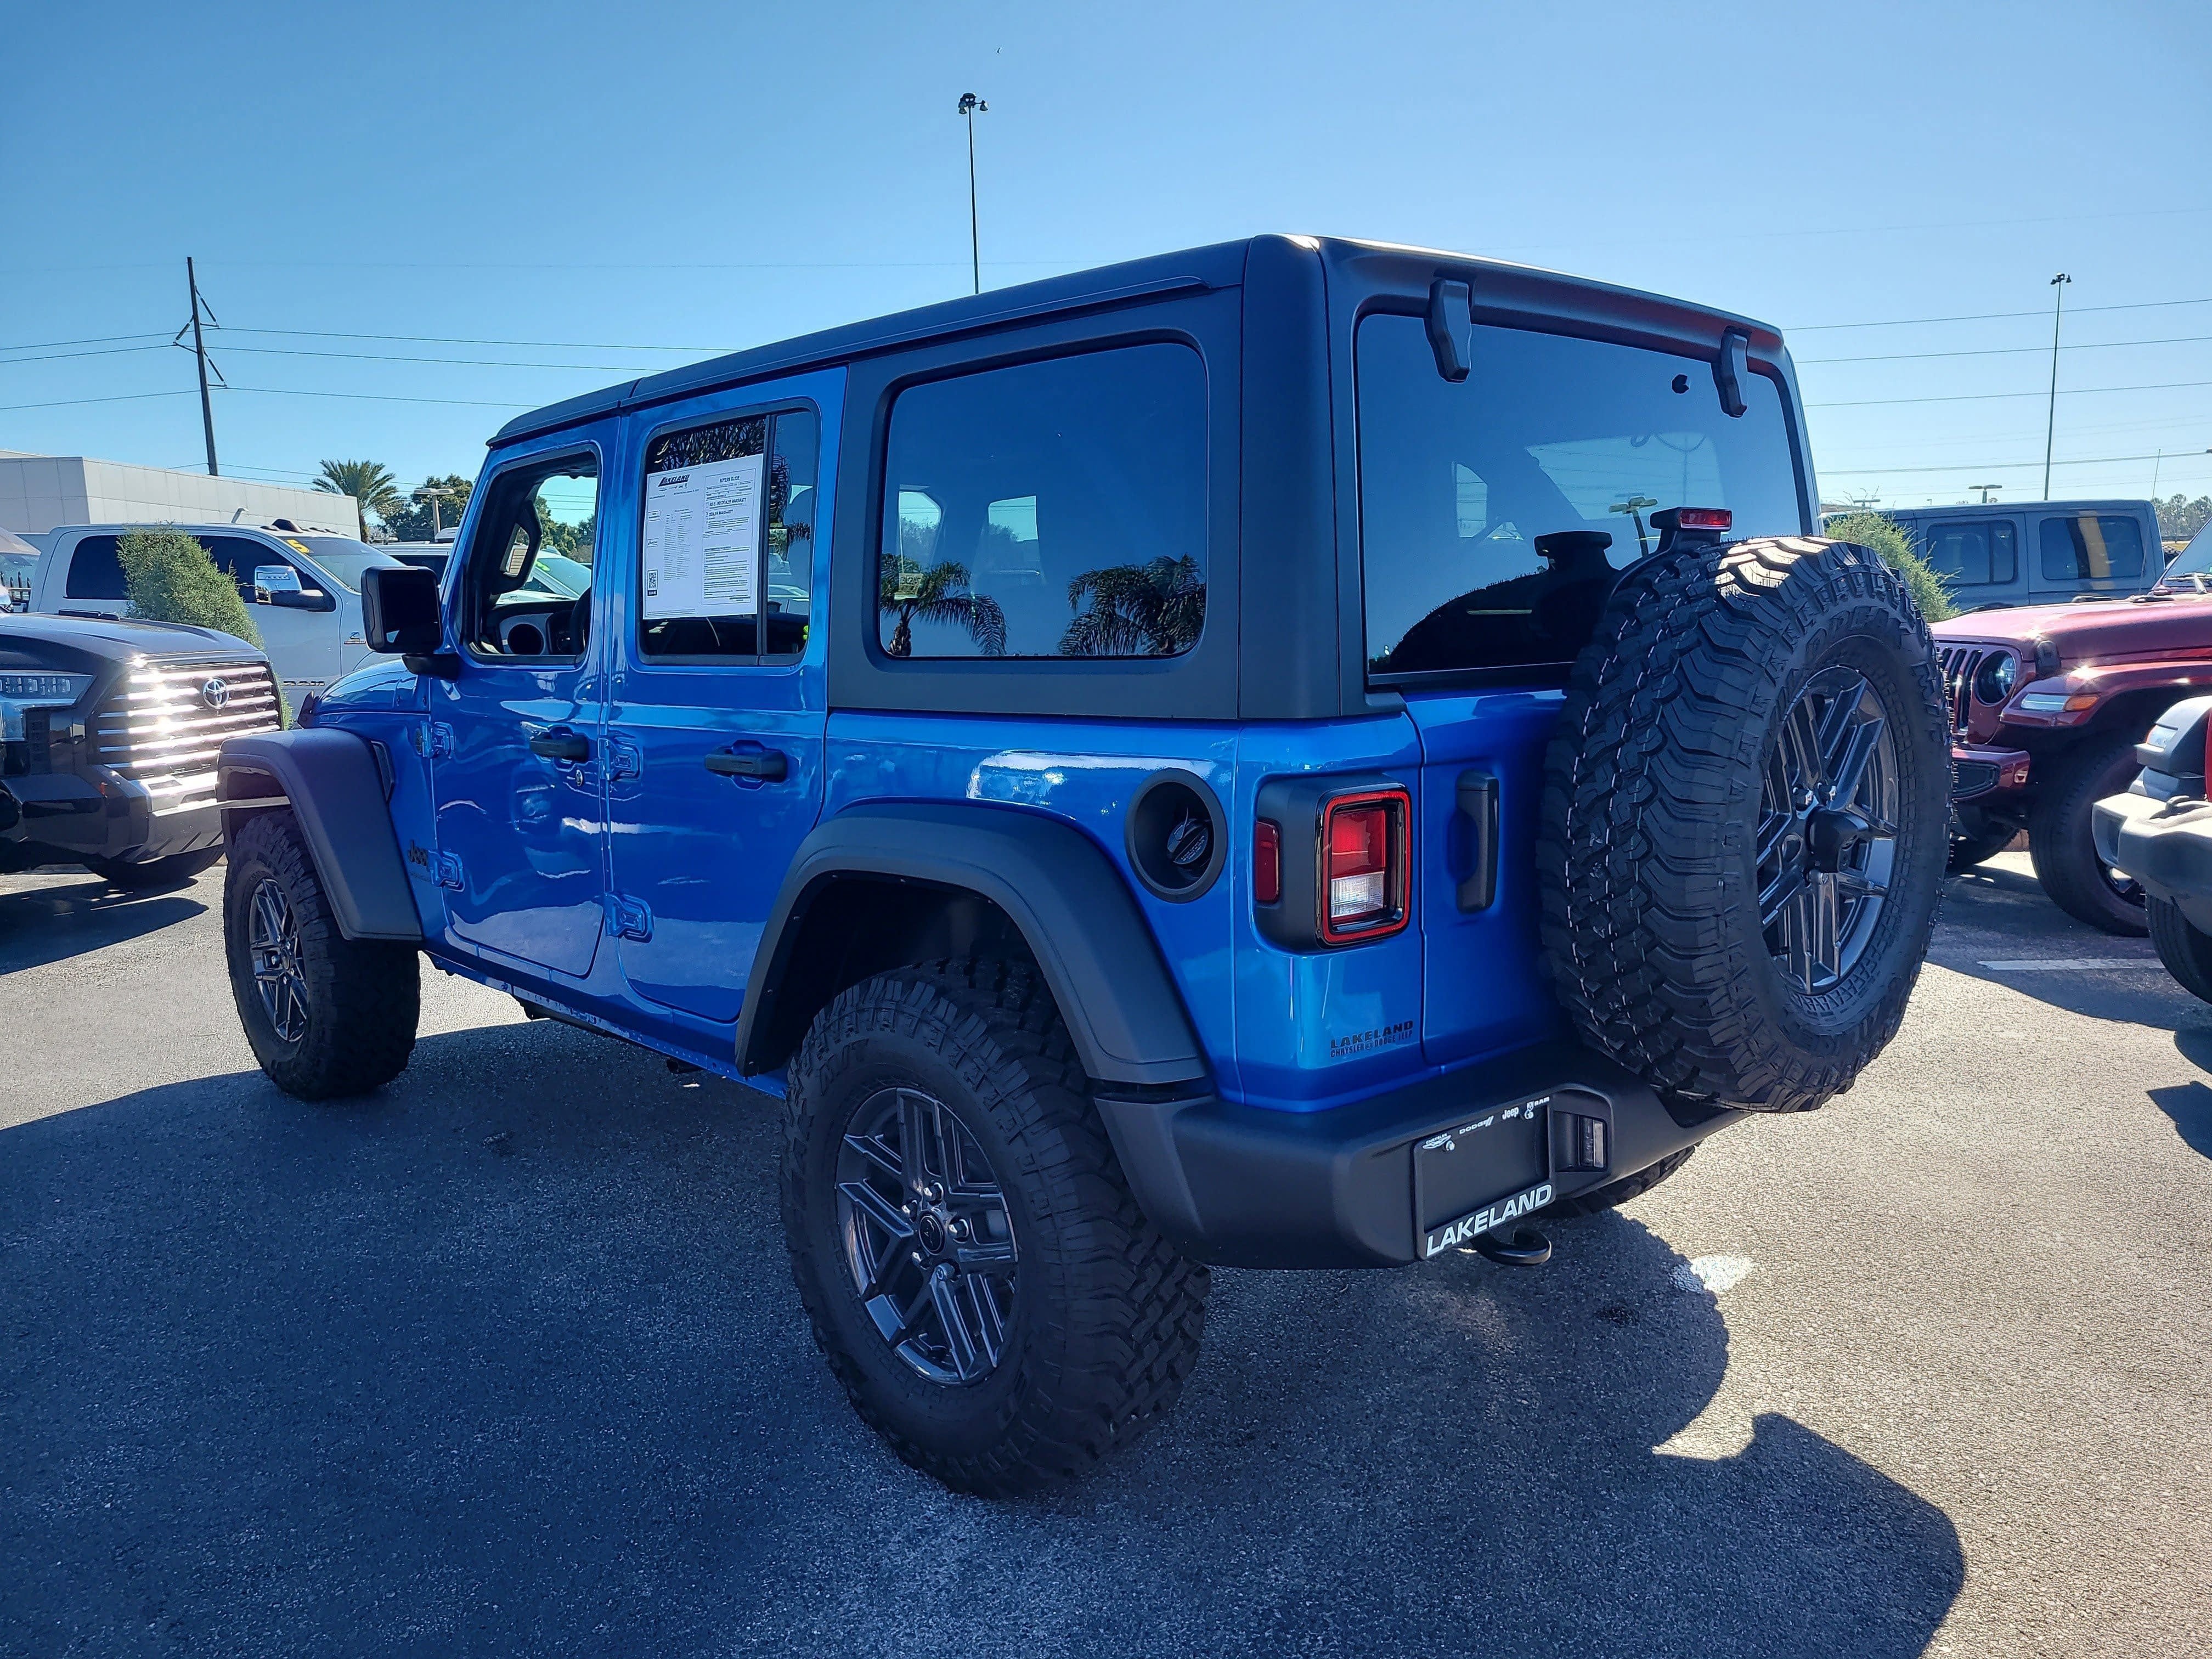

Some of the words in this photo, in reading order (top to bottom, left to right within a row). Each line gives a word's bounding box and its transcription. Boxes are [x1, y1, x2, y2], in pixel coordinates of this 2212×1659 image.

[658, 474, 690, 487] LAKELAND
[1330, 1020, 1413, 1048] LAKELAND
[1330, 1044, 1364, 1058] CHRYSLER
[1374, 1035, 1396, 1047] DODGE
[1398, 1030, 1413, 1041] JEEP
[1425, 1133, 1448, 1144] CHRYSLER
[1459, 1118, 1489, 1135] DODGE
[1502, 1107, 1519, 1120] Jeep
[1534, 1096, 1550, 1106] RAM
[1426, 1184, 1552, 1257] LAKELAND
